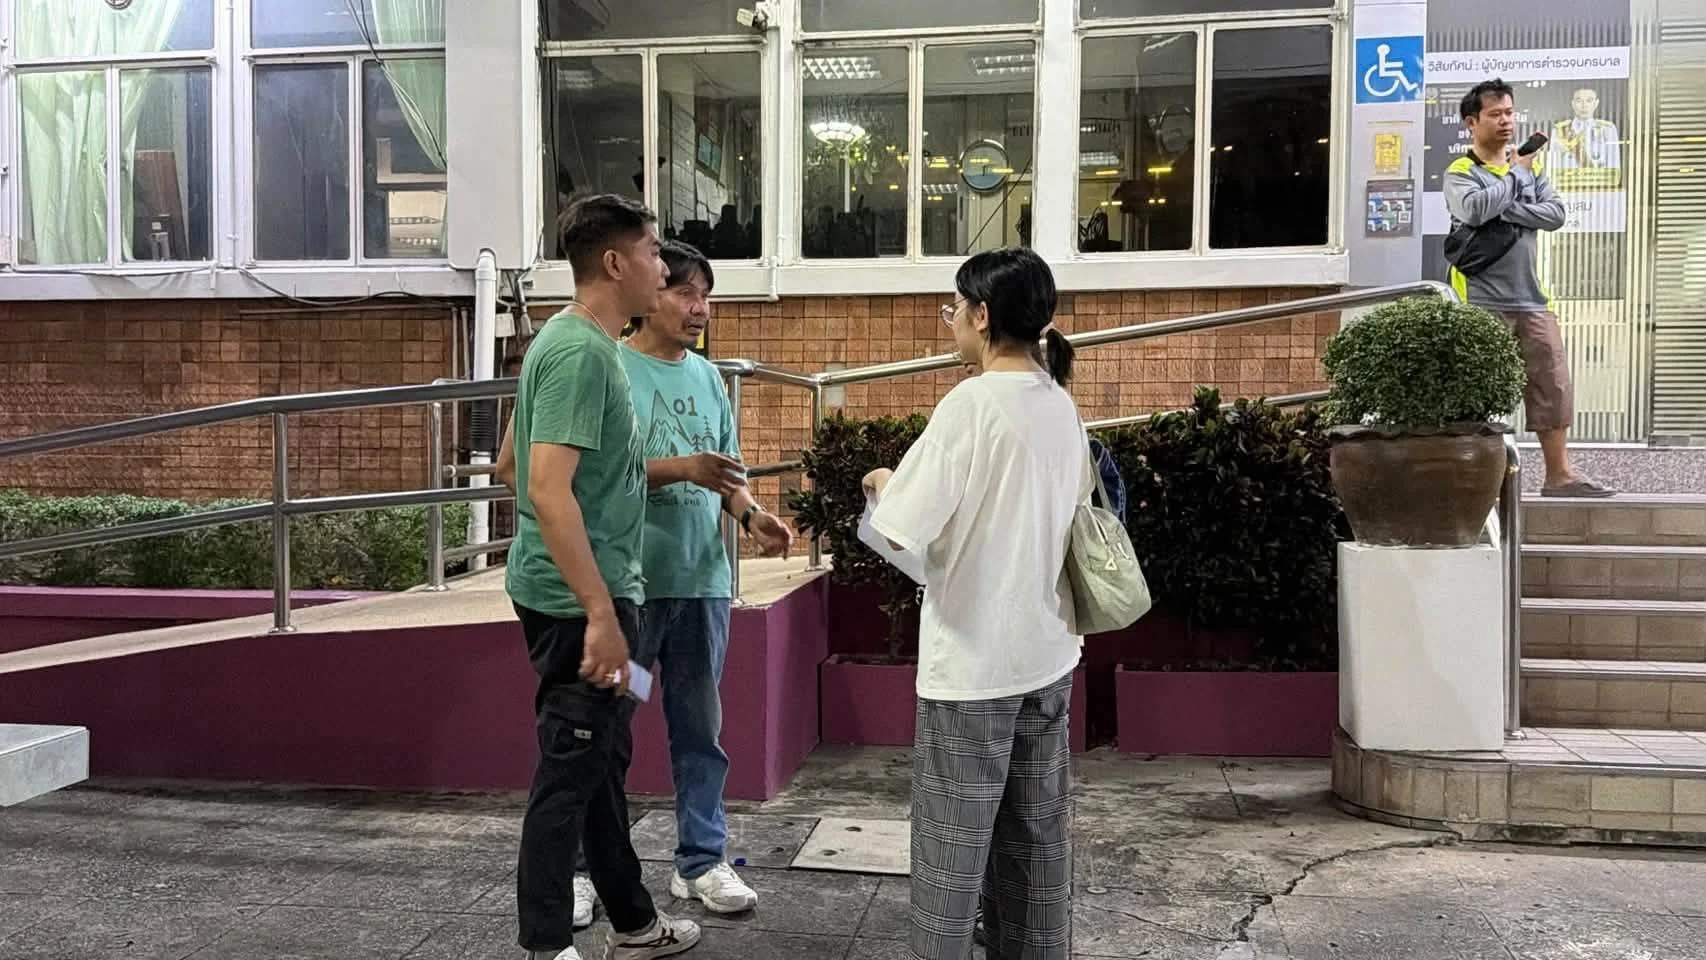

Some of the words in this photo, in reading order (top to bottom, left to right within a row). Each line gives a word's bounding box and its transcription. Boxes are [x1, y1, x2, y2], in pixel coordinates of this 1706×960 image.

[1481, 56, 1621, 74] ผู้บัญชาการตำรวจนครบาล
